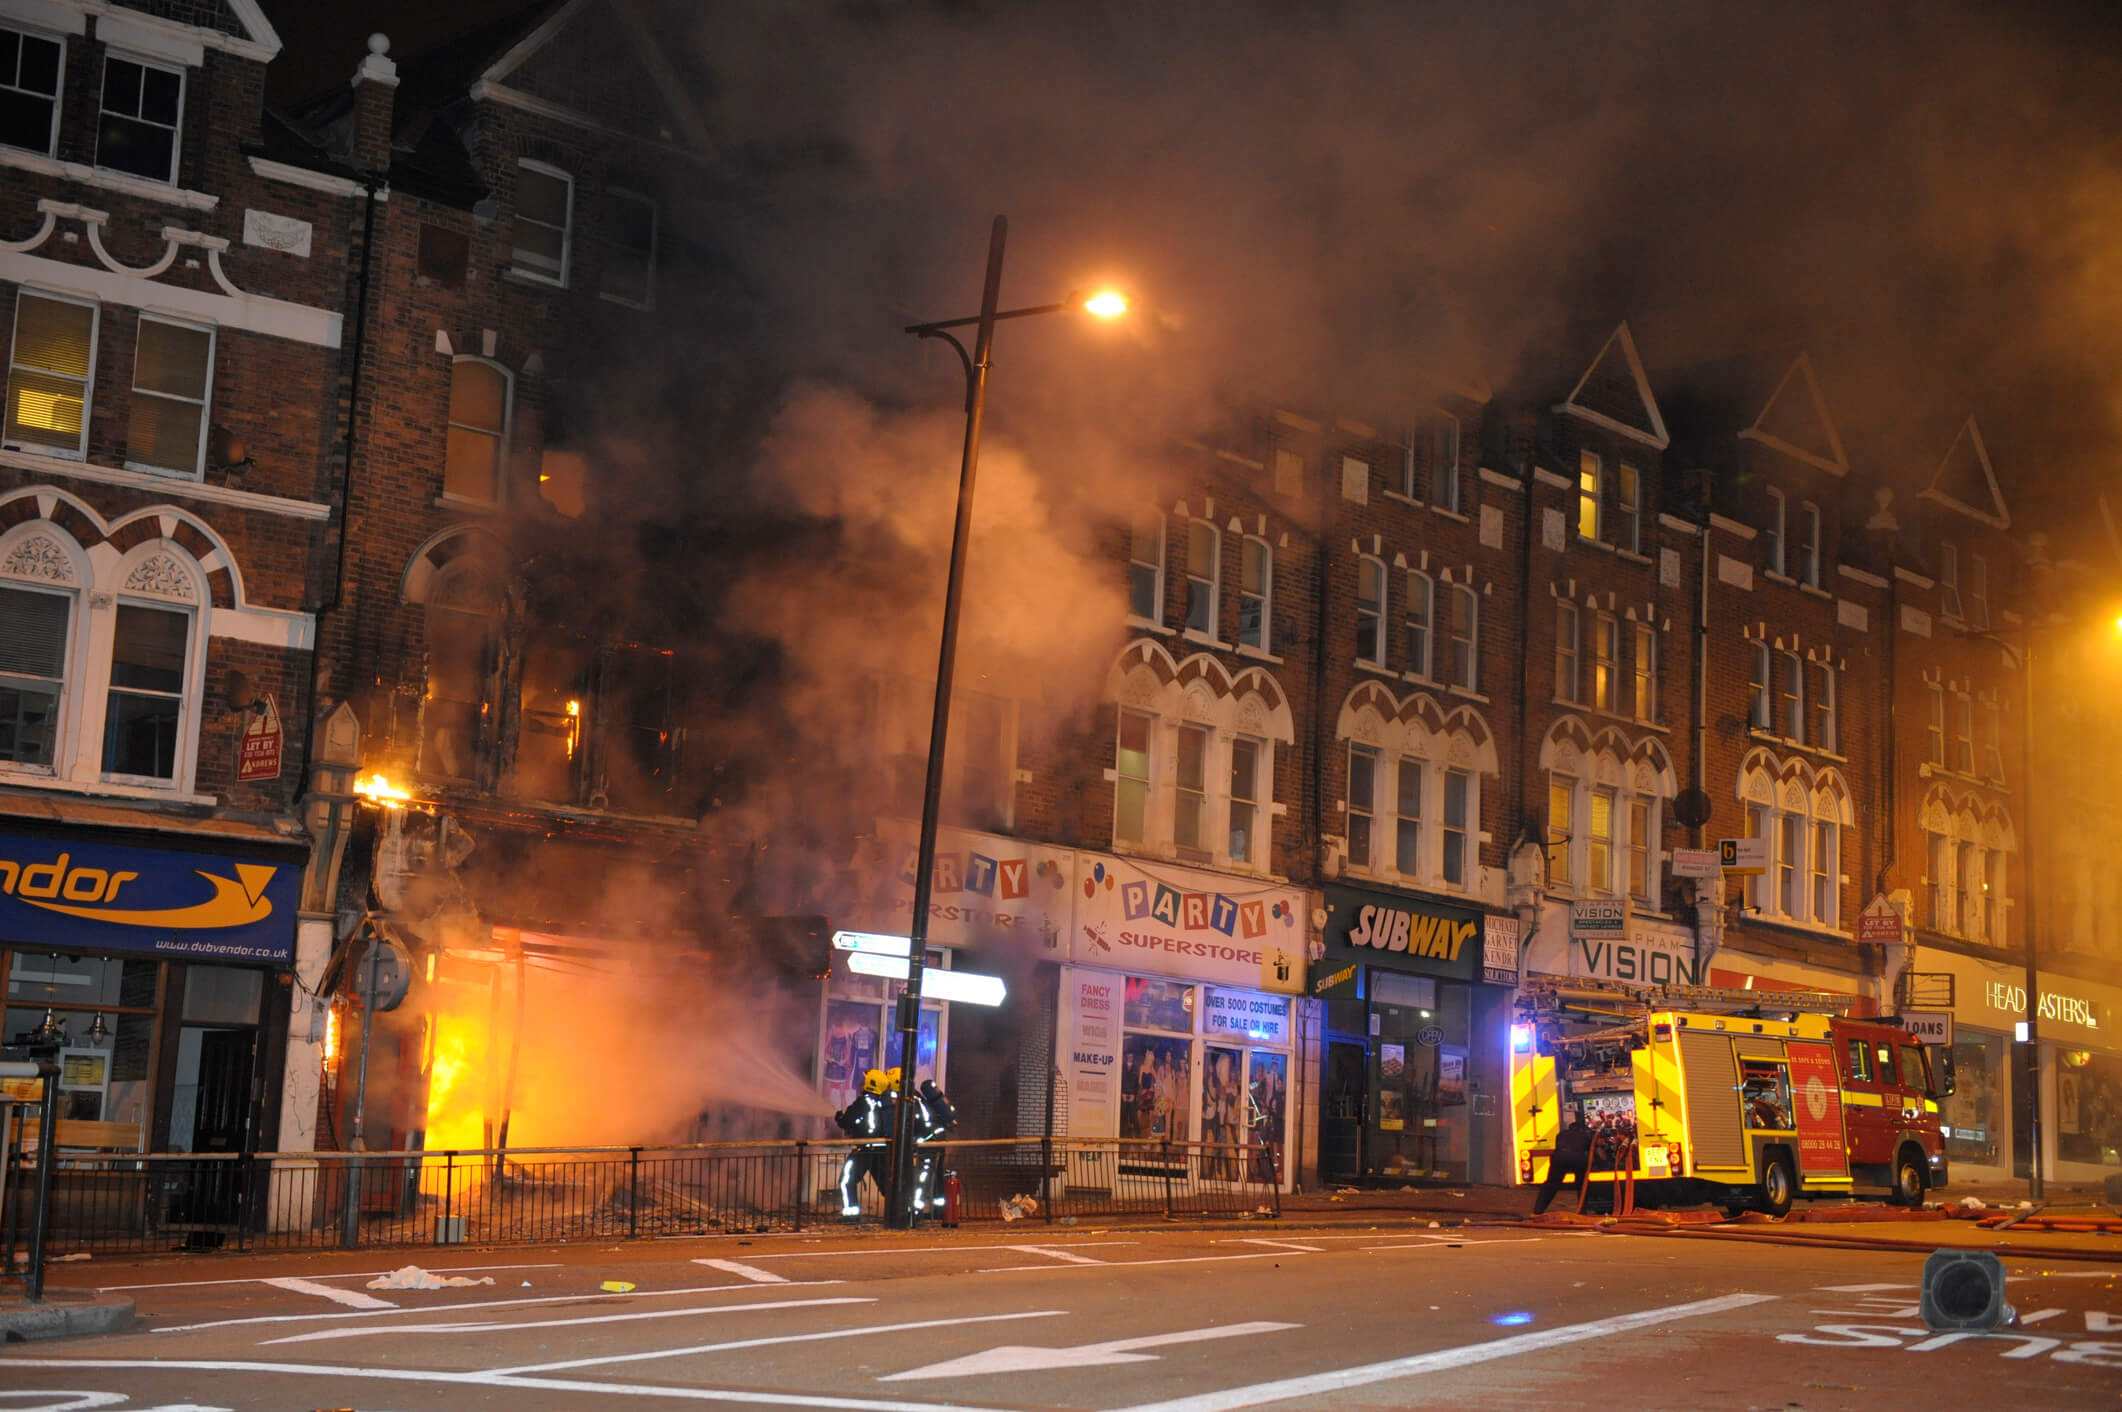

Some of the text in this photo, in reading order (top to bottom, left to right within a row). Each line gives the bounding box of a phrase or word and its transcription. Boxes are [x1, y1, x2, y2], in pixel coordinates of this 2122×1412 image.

[1126, 885, 1262, 935] PARTY
[1575, 908, 1623, 918] VISION
[1349, 904, 1478, 961] SUBWAY
[155, 939, 289, 960] www.dubvendor.co.uk
[1118, 931, 1263, 966] SUPERSTORE
[1580, 938, 1697, 985] VISION
[1315, 964, 1357, 993] SUBWAY
[1081, 983, 1111, 998] FANCY
[1080, 998, 1111, 1011] DRESS
[1206, 995, 1225, 1010] OVER
[1228, 996, 1247, 1012] 5000
[1249, 1001, 1289, 1018] COSTUMES
[1985, 980, 2088, 1025] HEADASTERS
[1212, 1014, 1227, 1028] FOR
[1230, 1018, 1248, 1031] SALE
[1262, 1021, 1279, 1034] HIRE
[1905, 1021, 1944, 1036] LOANS
[1073, 1051, 1114, 1065] MAKE-UP
